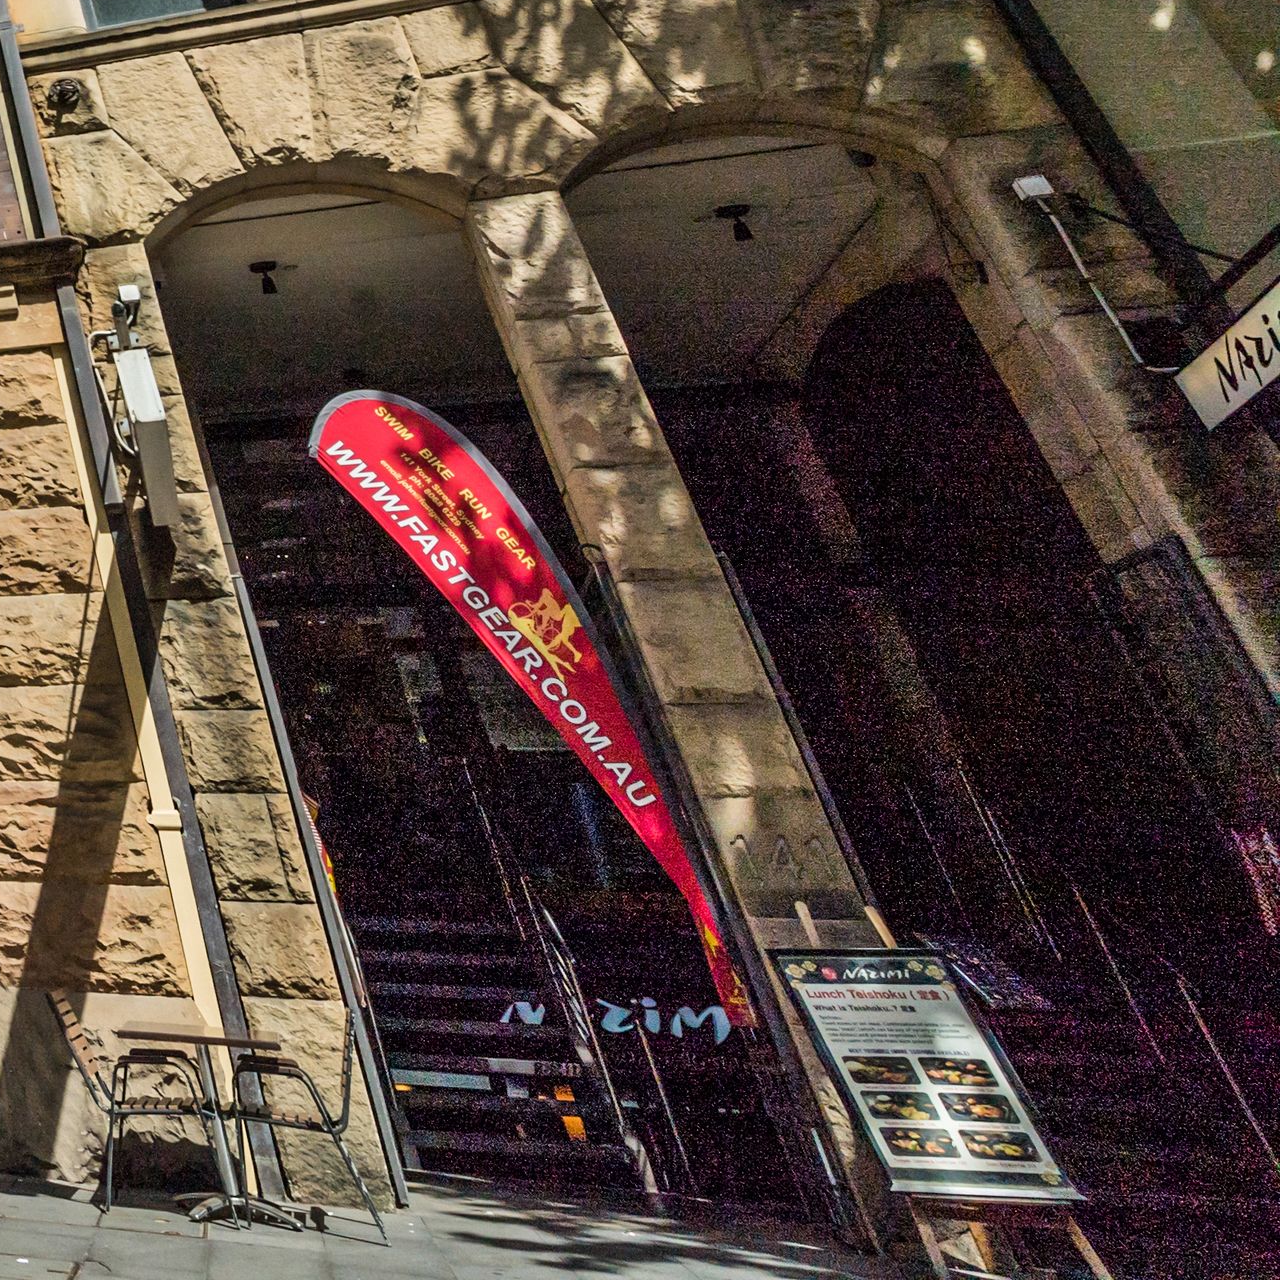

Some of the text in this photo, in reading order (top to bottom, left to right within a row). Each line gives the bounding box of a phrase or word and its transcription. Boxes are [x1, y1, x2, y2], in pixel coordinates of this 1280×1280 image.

[374, 406, 536, 570] SWIM BIKE RUN GEAR
[400, 452, 415, 466] 141
[415, 465, 432, 485] York
[456, 509, 485, 541] Sydney
[408, 475, 424, 489] ph:
[326, 440, 656, 808] WWW.FASTGEAR.COM.AU
[806, 990, 845, 1000] Lunch
[846, 989, 907, 1001] Teishoku
[813, 1004, 837, 1012] What
